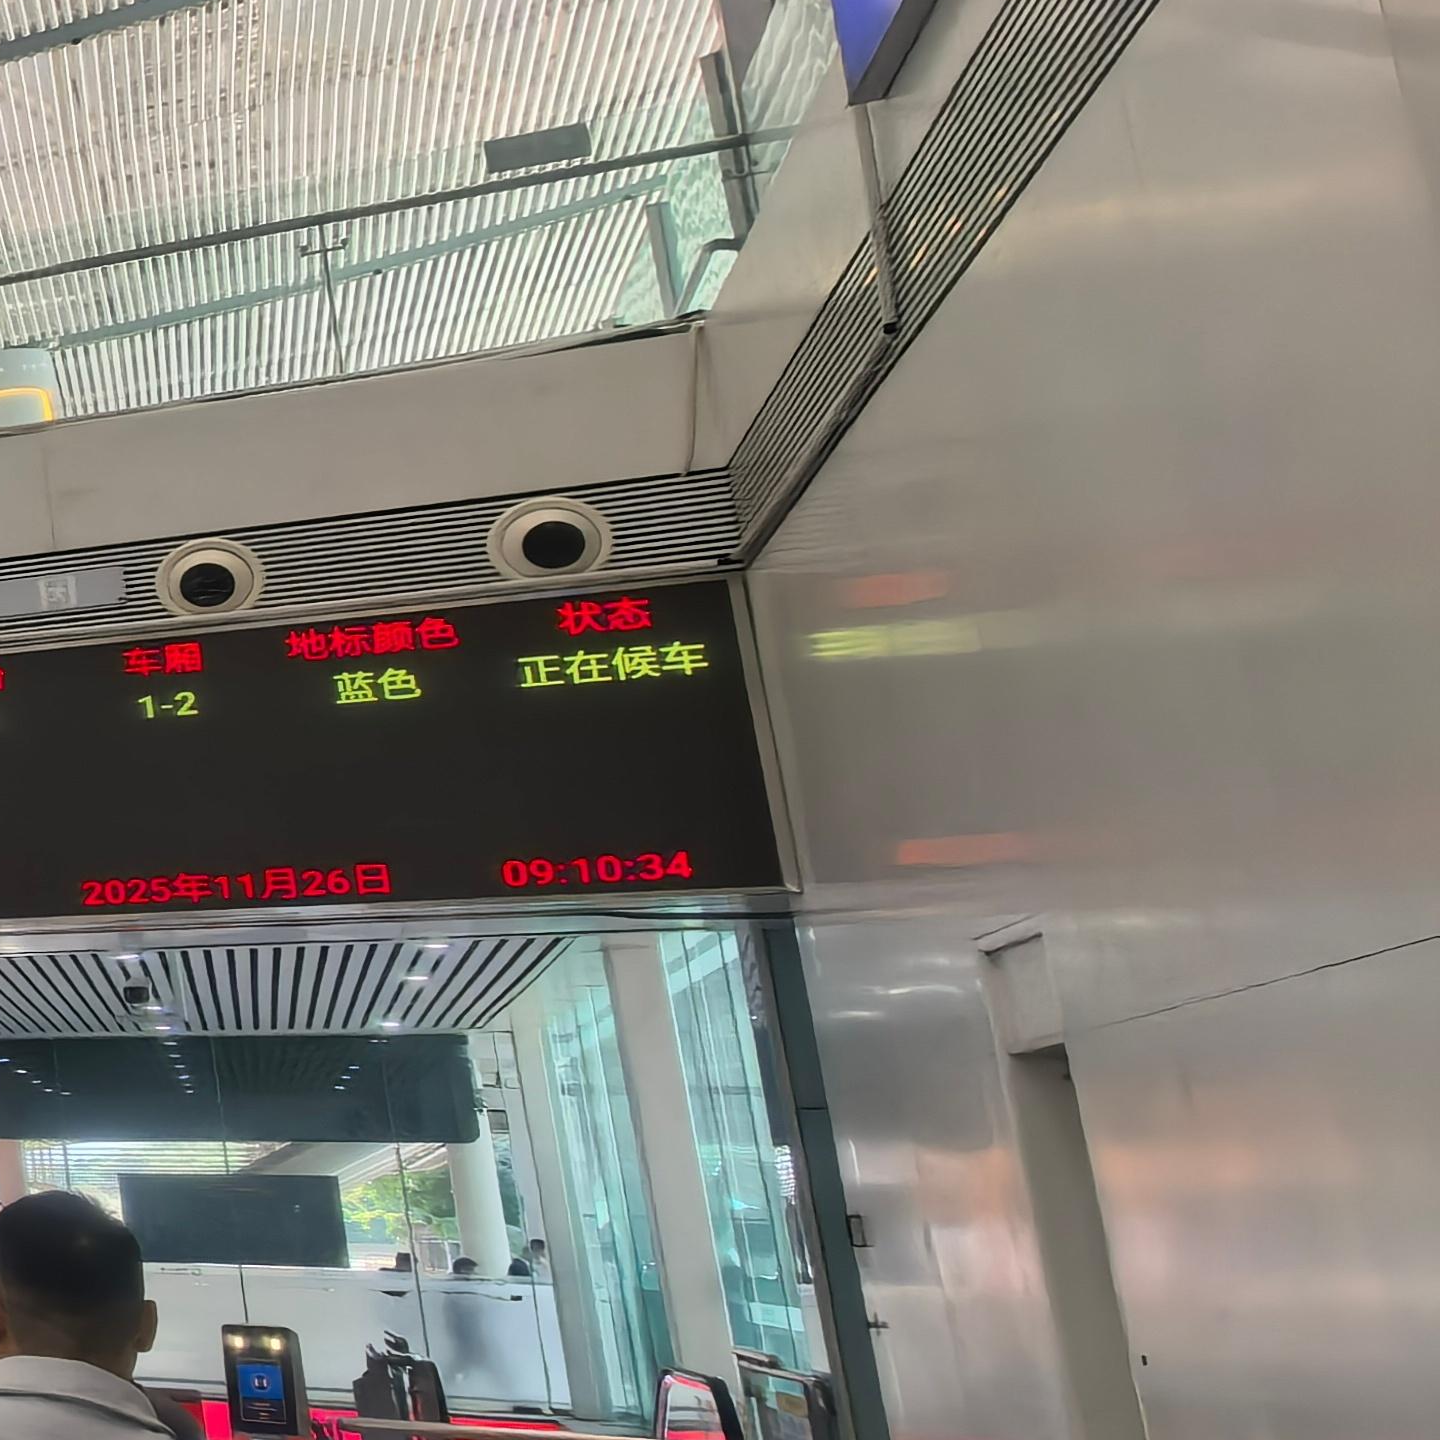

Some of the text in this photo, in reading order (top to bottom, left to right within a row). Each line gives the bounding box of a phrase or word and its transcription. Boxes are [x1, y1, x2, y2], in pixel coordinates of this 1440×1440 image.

[123, 642, 205, 678] 车厢
[285, 617, 461, 662] 地标颜色
[557, 596, 653, 638] 状态
[138, 691, 199, 720] 1-2
[334, 667, 423, 707] 蓝色
[519, 641, 710, 690] 正在候车
[81, 863, 393, 907] 2025年11月26日
[501, 850, 694, 888] 09:10:34
